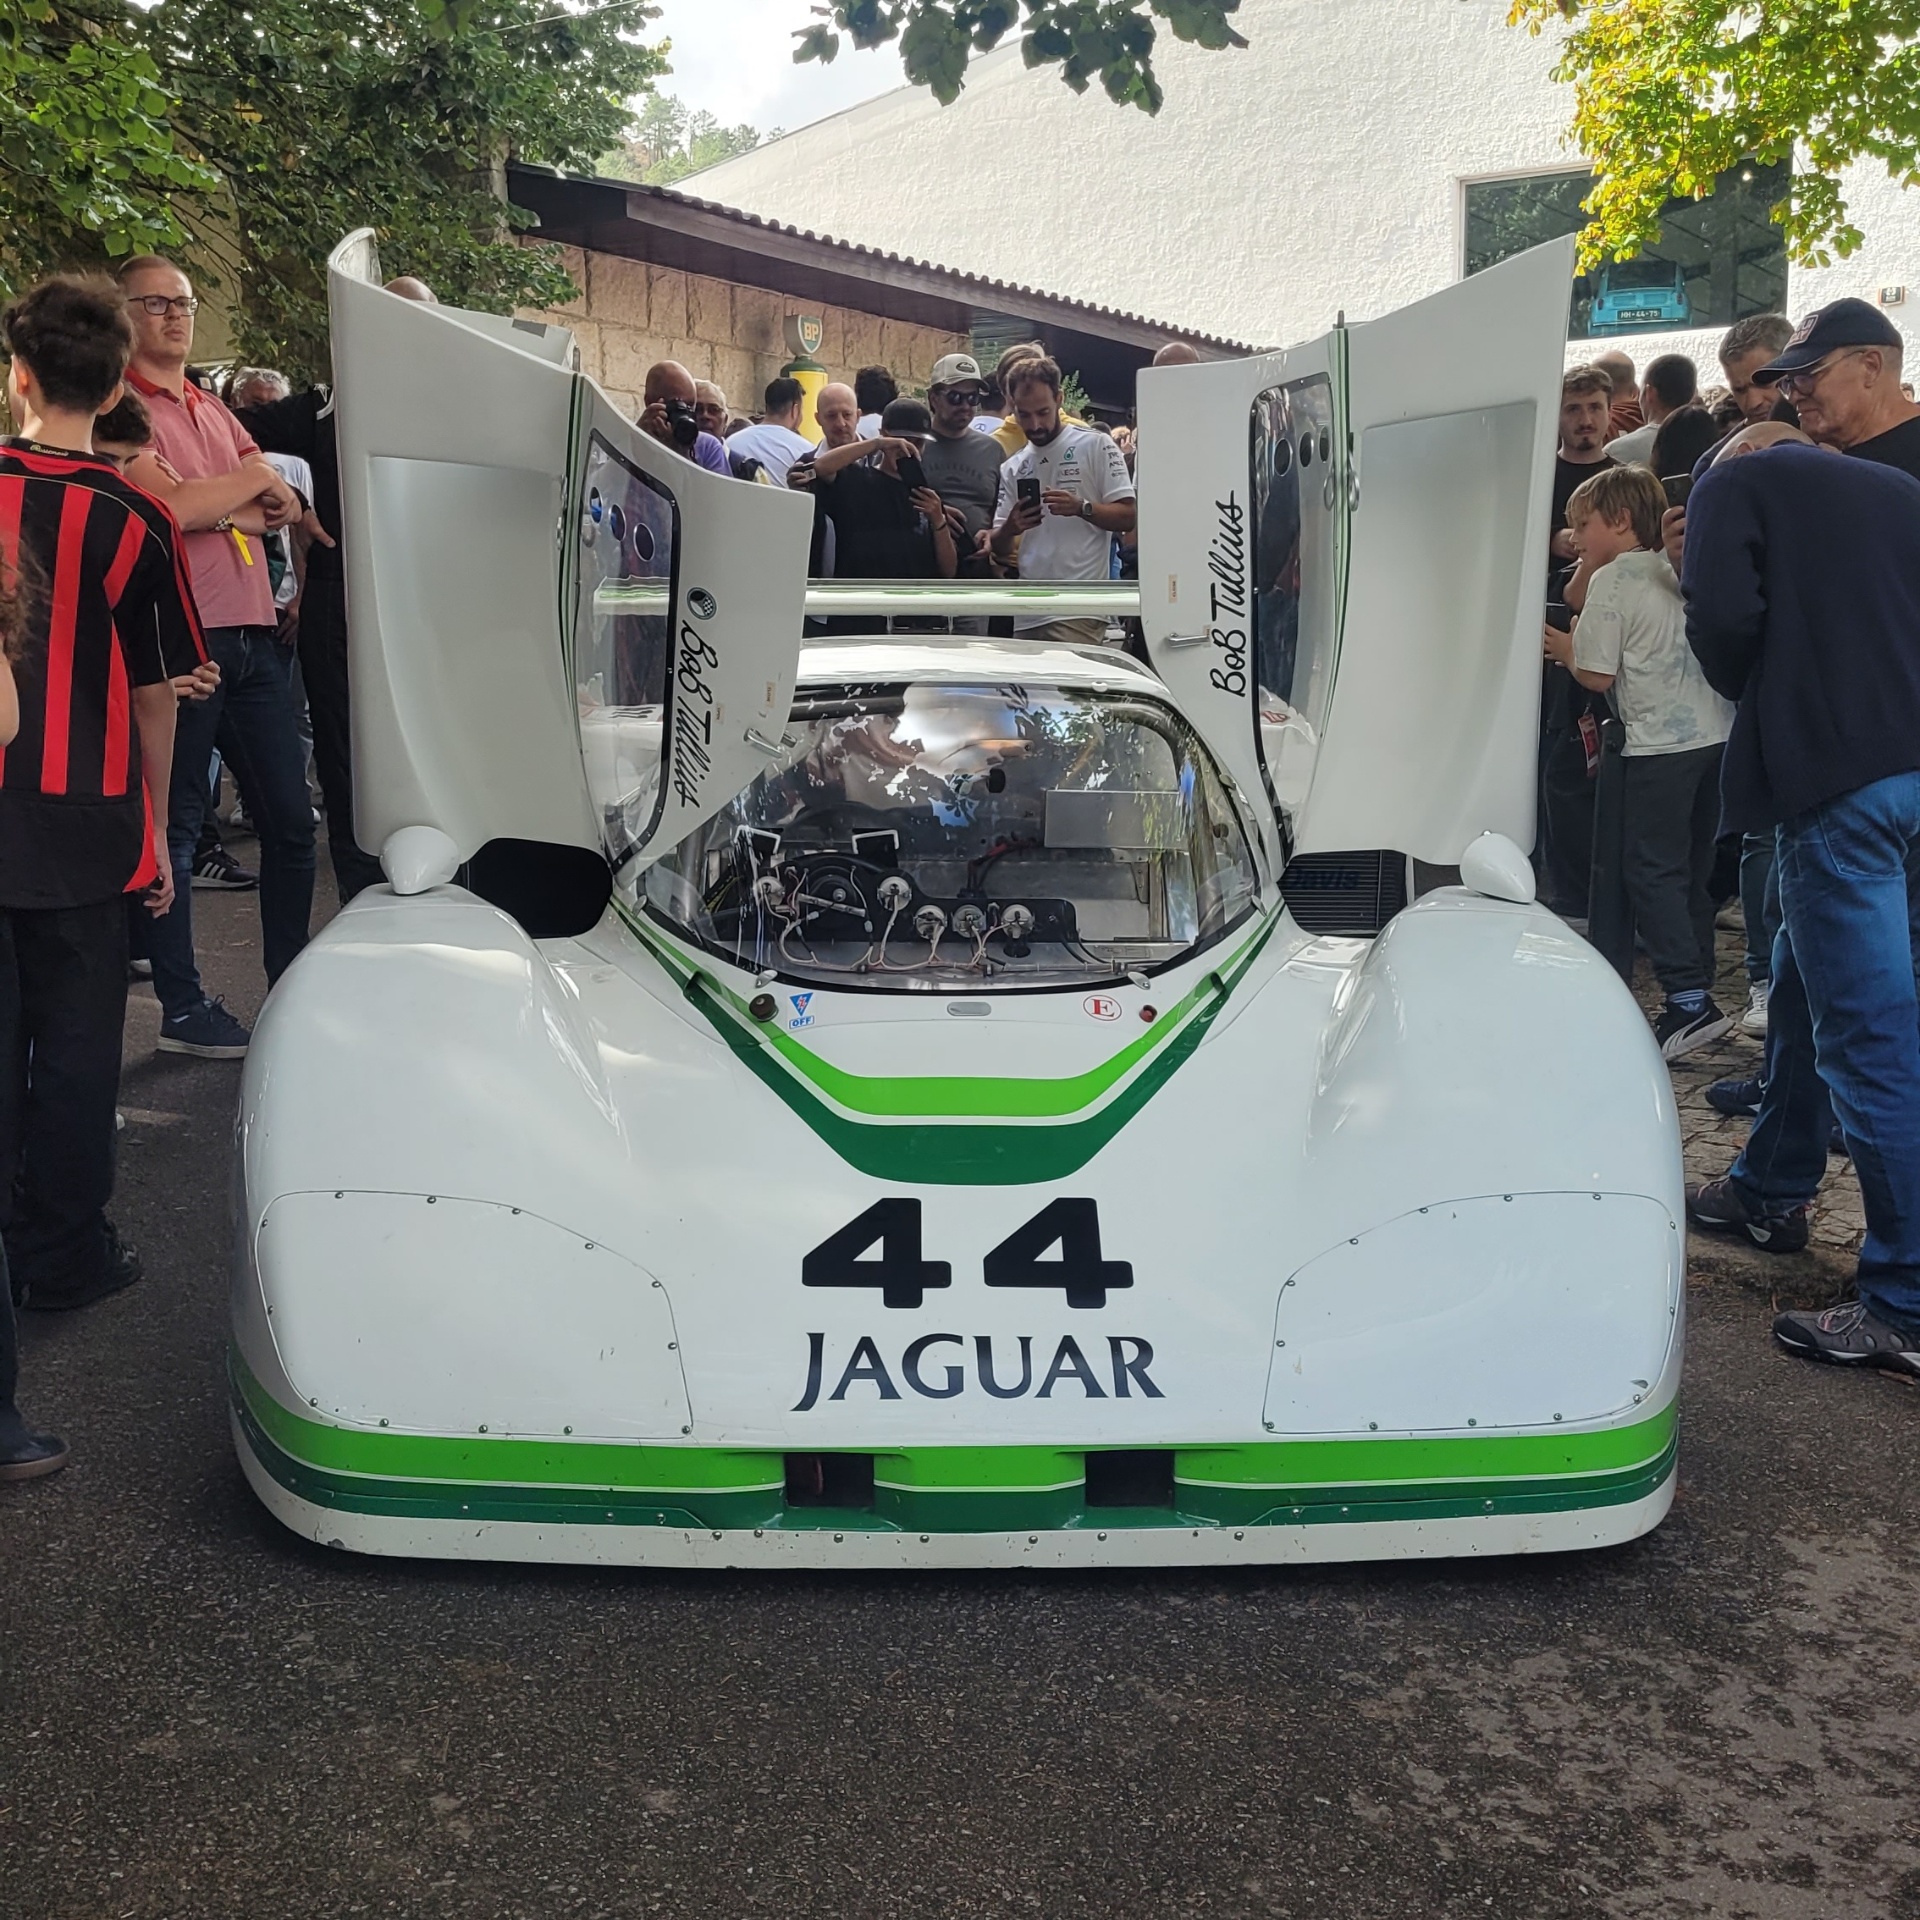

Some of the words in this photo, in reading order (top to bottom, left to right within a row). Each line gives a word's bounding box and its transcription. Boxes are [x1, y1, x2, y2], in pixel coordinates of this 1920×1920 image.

[803, 321, 819, 341] BP
[1207, 489, 1246, 622] Tullius
[673, 695, 711, 808] Tullius
[792, 1017, 811, 1027] OFF
[1091, 998, 1115, 1017] E
[802, 1197, 1134, 1309] 44
[790, 1332, 1166, 1412] JAGUAR
